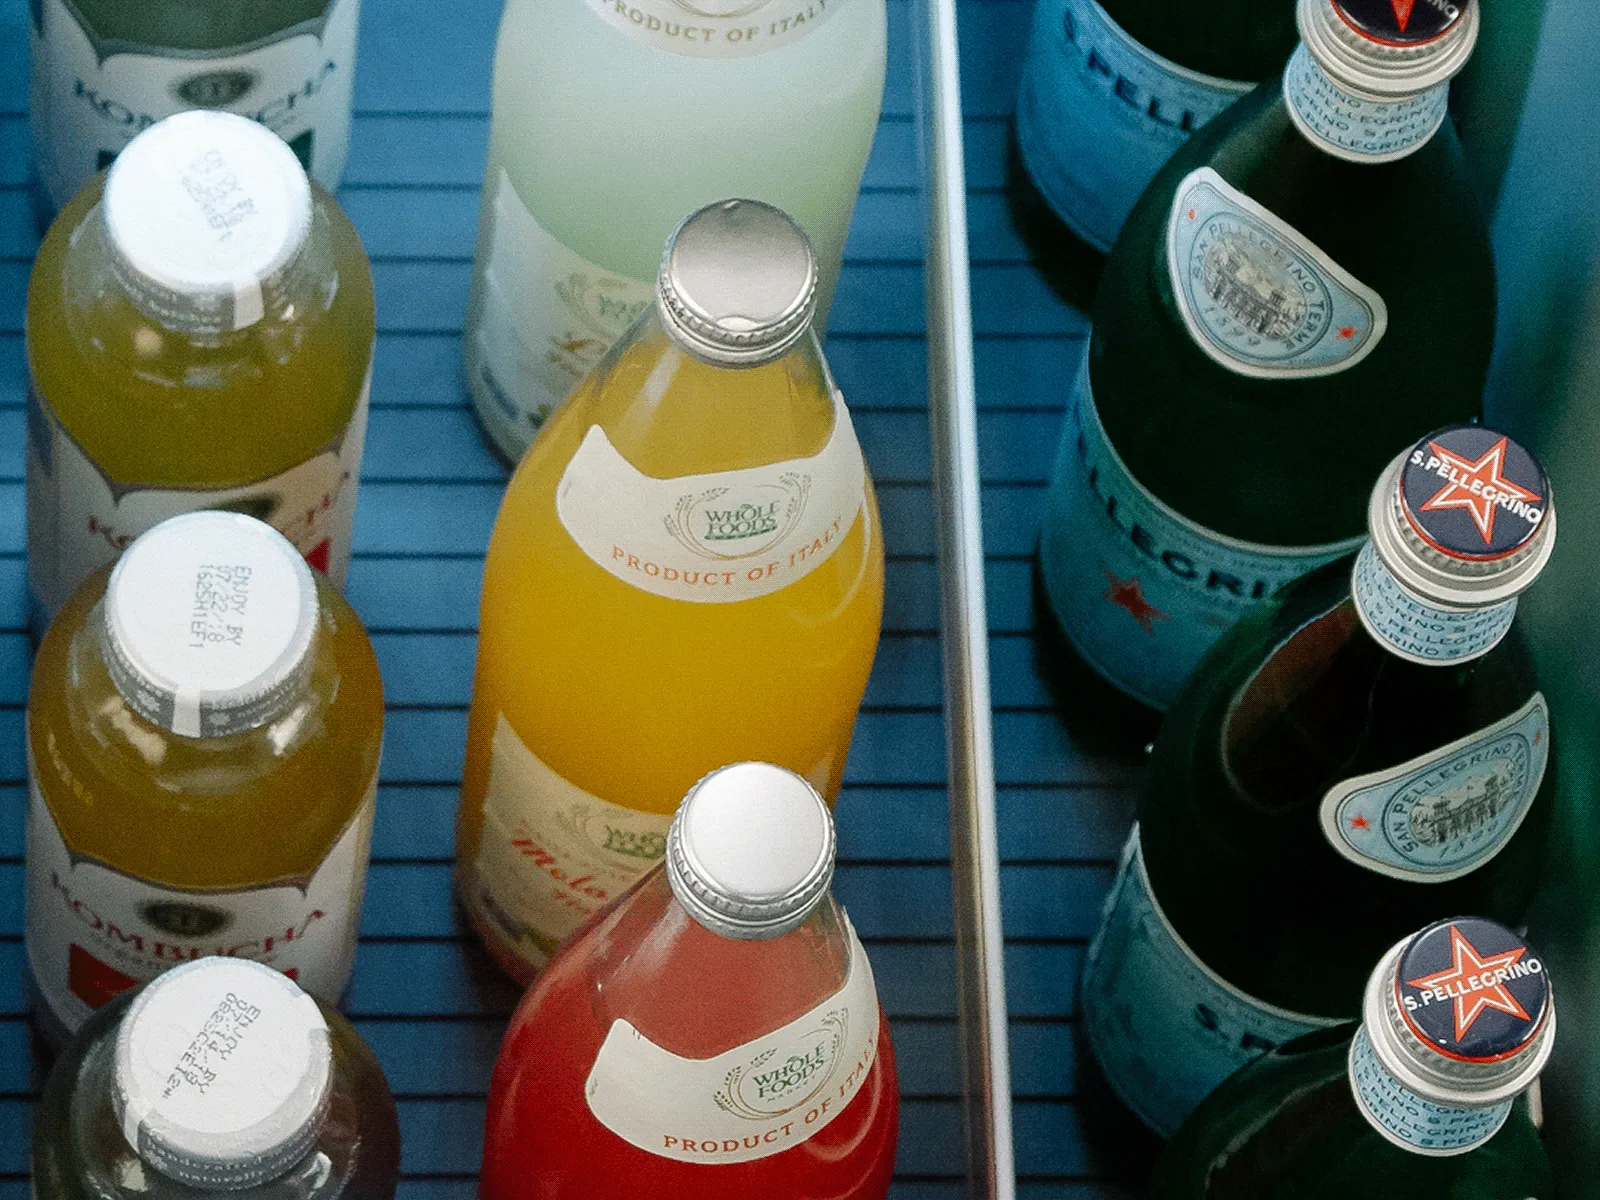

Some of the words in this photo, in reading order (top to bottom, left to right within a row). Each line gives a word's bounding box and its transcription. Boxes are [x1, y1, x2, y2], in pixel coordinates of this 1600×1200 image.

[605, 0, 716, 42] RODUCT
[727, 27, 760, 43] OF
[1281, 300, 1325, 351] TERME
[706, 500, 780, 522] WHOLE
[1410, 450, 1543, 524] S.PELLEGRINO
[707, 515, 777, 536] FOODS
[611, 543, 735, 585] PRODUCT
[747, 561, 781, 581] OF
[789, 516, 842, 568] ITALY
[230, 565, 252, 616] ENJOY
[228, 623, 244, 646] BY
[1391, 742, 1513, 815] PELLEGRINO
[1394, 820, 1419, 853] SAN
[1402, 958, 1542, 1011] S.PELLEGRINO
[220, 1004, 262, 1061] ENJOY
[197, 1067, 217, 1094] BY
[752, 1040, 826, 1087] WHOLE
[757, 1055, 825, 1099] FOODS
[663, 1121, 794, 1153] PRODUCT
[803, 1096, 832, 1125] OF
